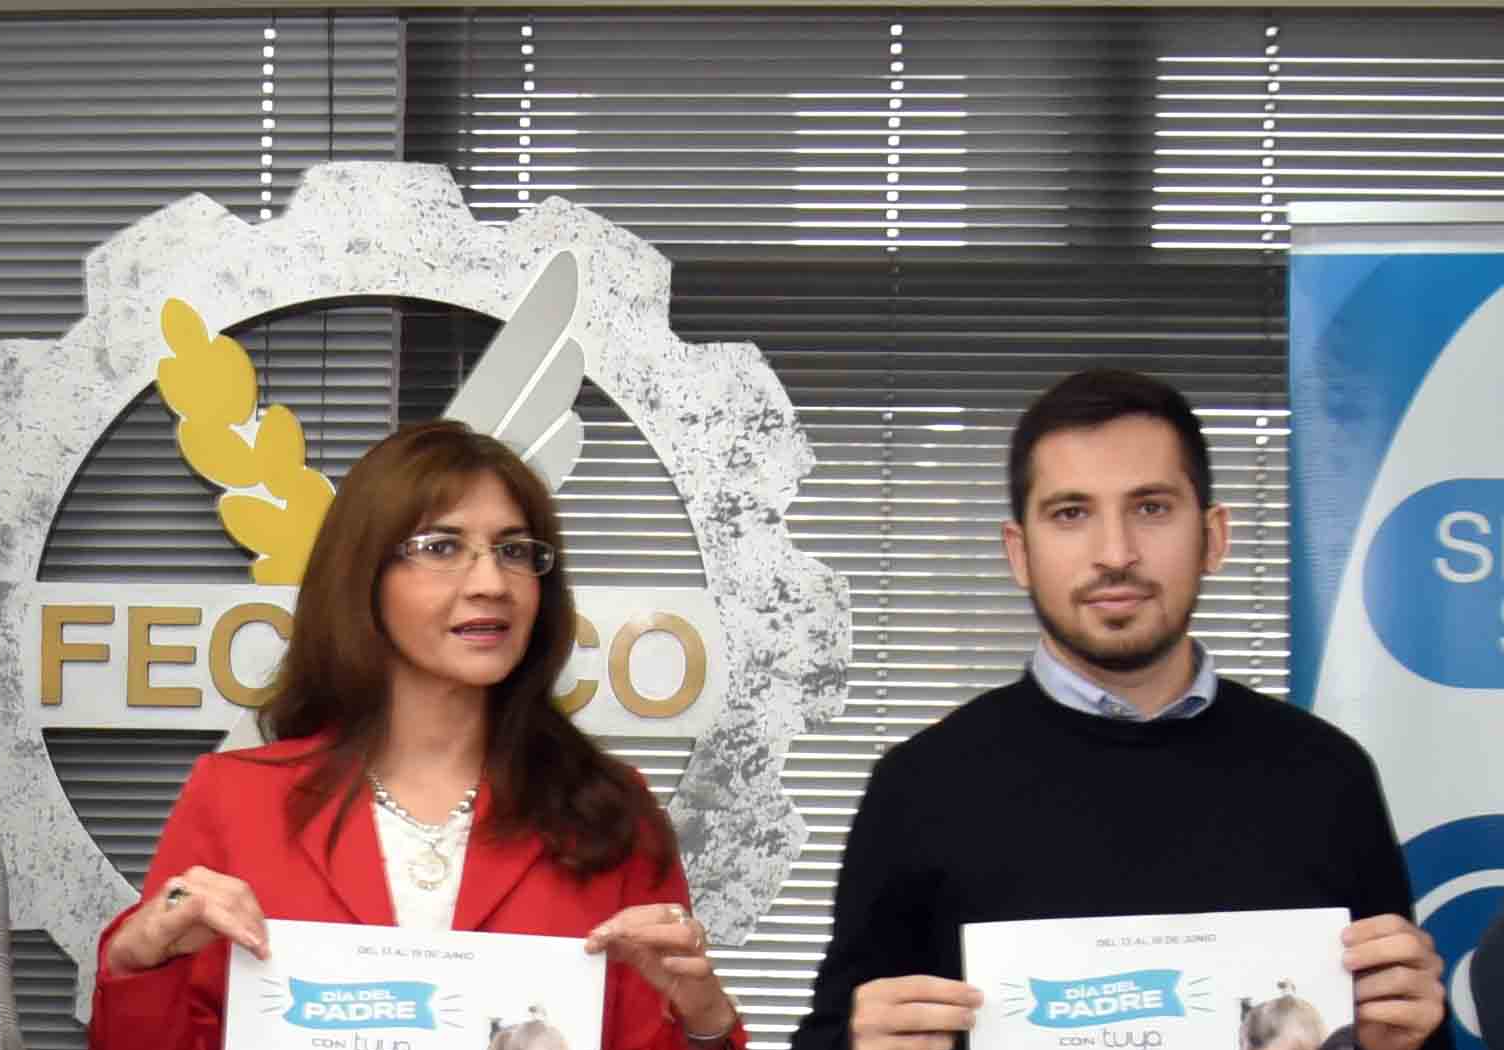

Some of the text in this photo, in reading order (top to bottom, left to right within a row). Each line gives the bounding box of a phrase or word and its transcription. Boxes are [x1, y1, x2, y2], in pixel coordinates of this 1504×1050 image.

[321, 987, 396, 1003] DÍA DEL
[1065, 980, 1141, 999] DÍA DEL
[303, 993, 416, 1026] PADRE
[1047, 989, 1163, 1019] PADRE
